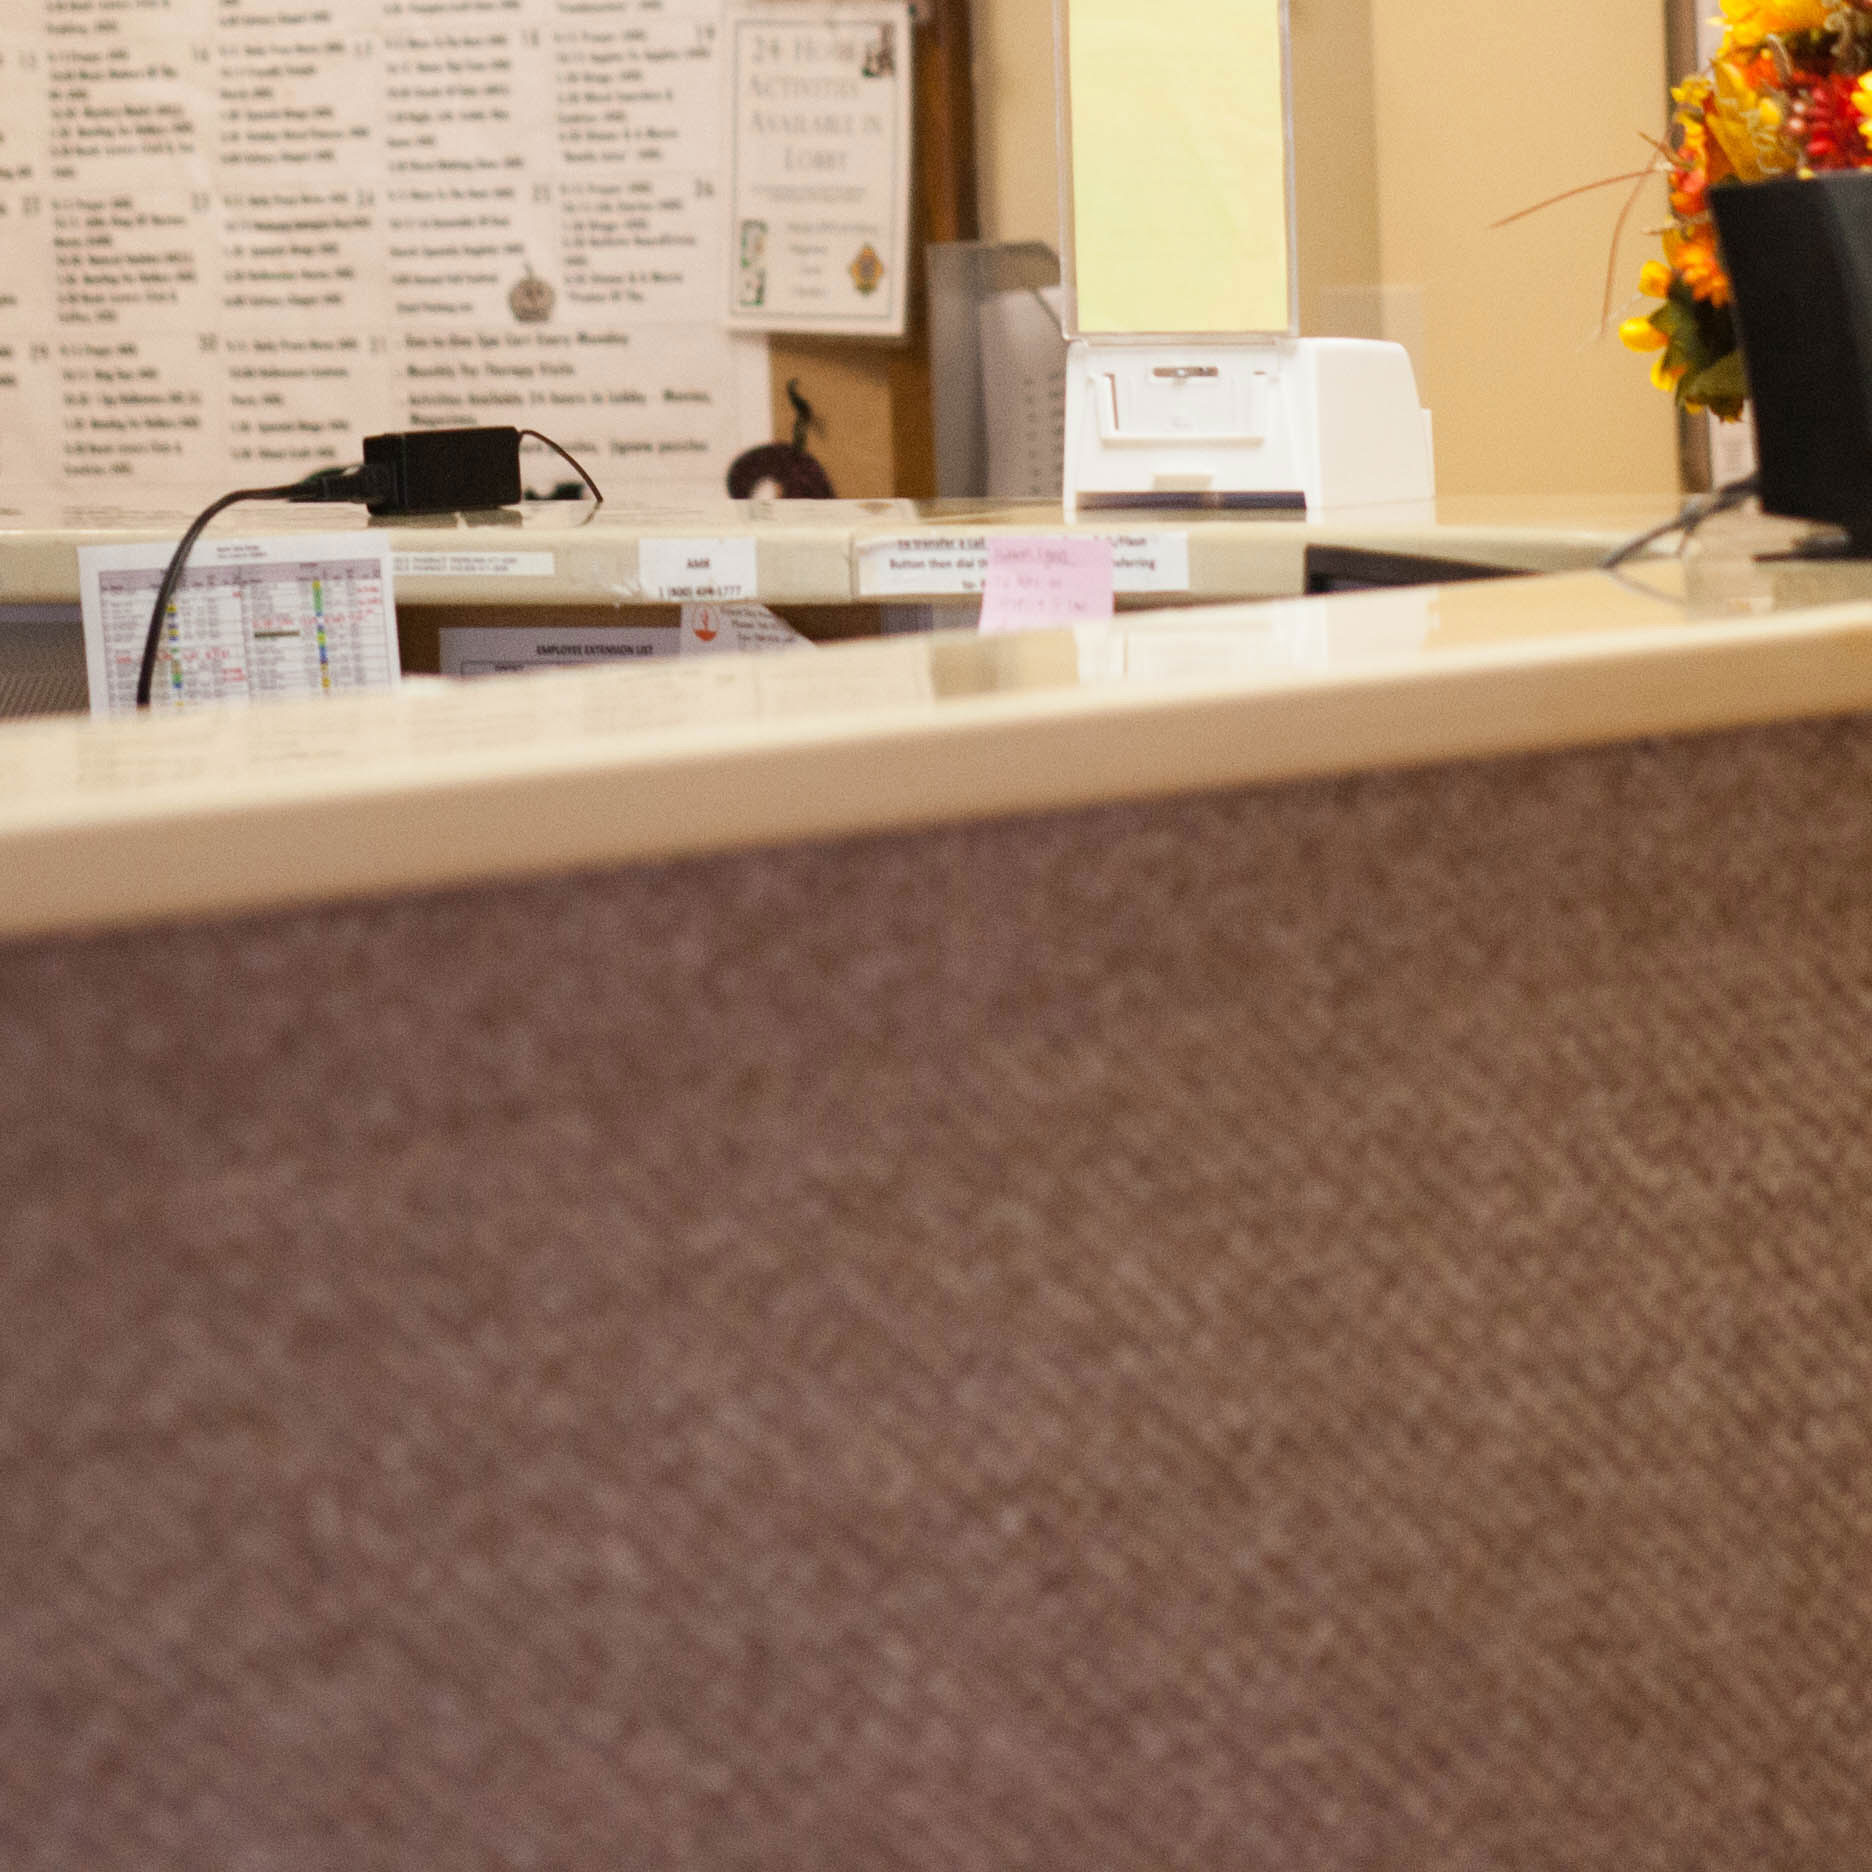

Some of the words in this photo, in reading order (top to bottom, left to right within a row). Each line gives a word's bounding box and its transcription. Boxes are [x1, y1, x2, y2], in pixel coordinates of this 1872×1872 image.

[913, 537, 955, 550] transfer
[889, 557, 926, 570] Button
[928, 557, 953, 570] then
[956, 556, 976, 569] dial
[536, 644, 583, 657] EMPLOYEE
[584, 643, 634, 656] EXTENSION
[635, 644, 654, 655] LIST
